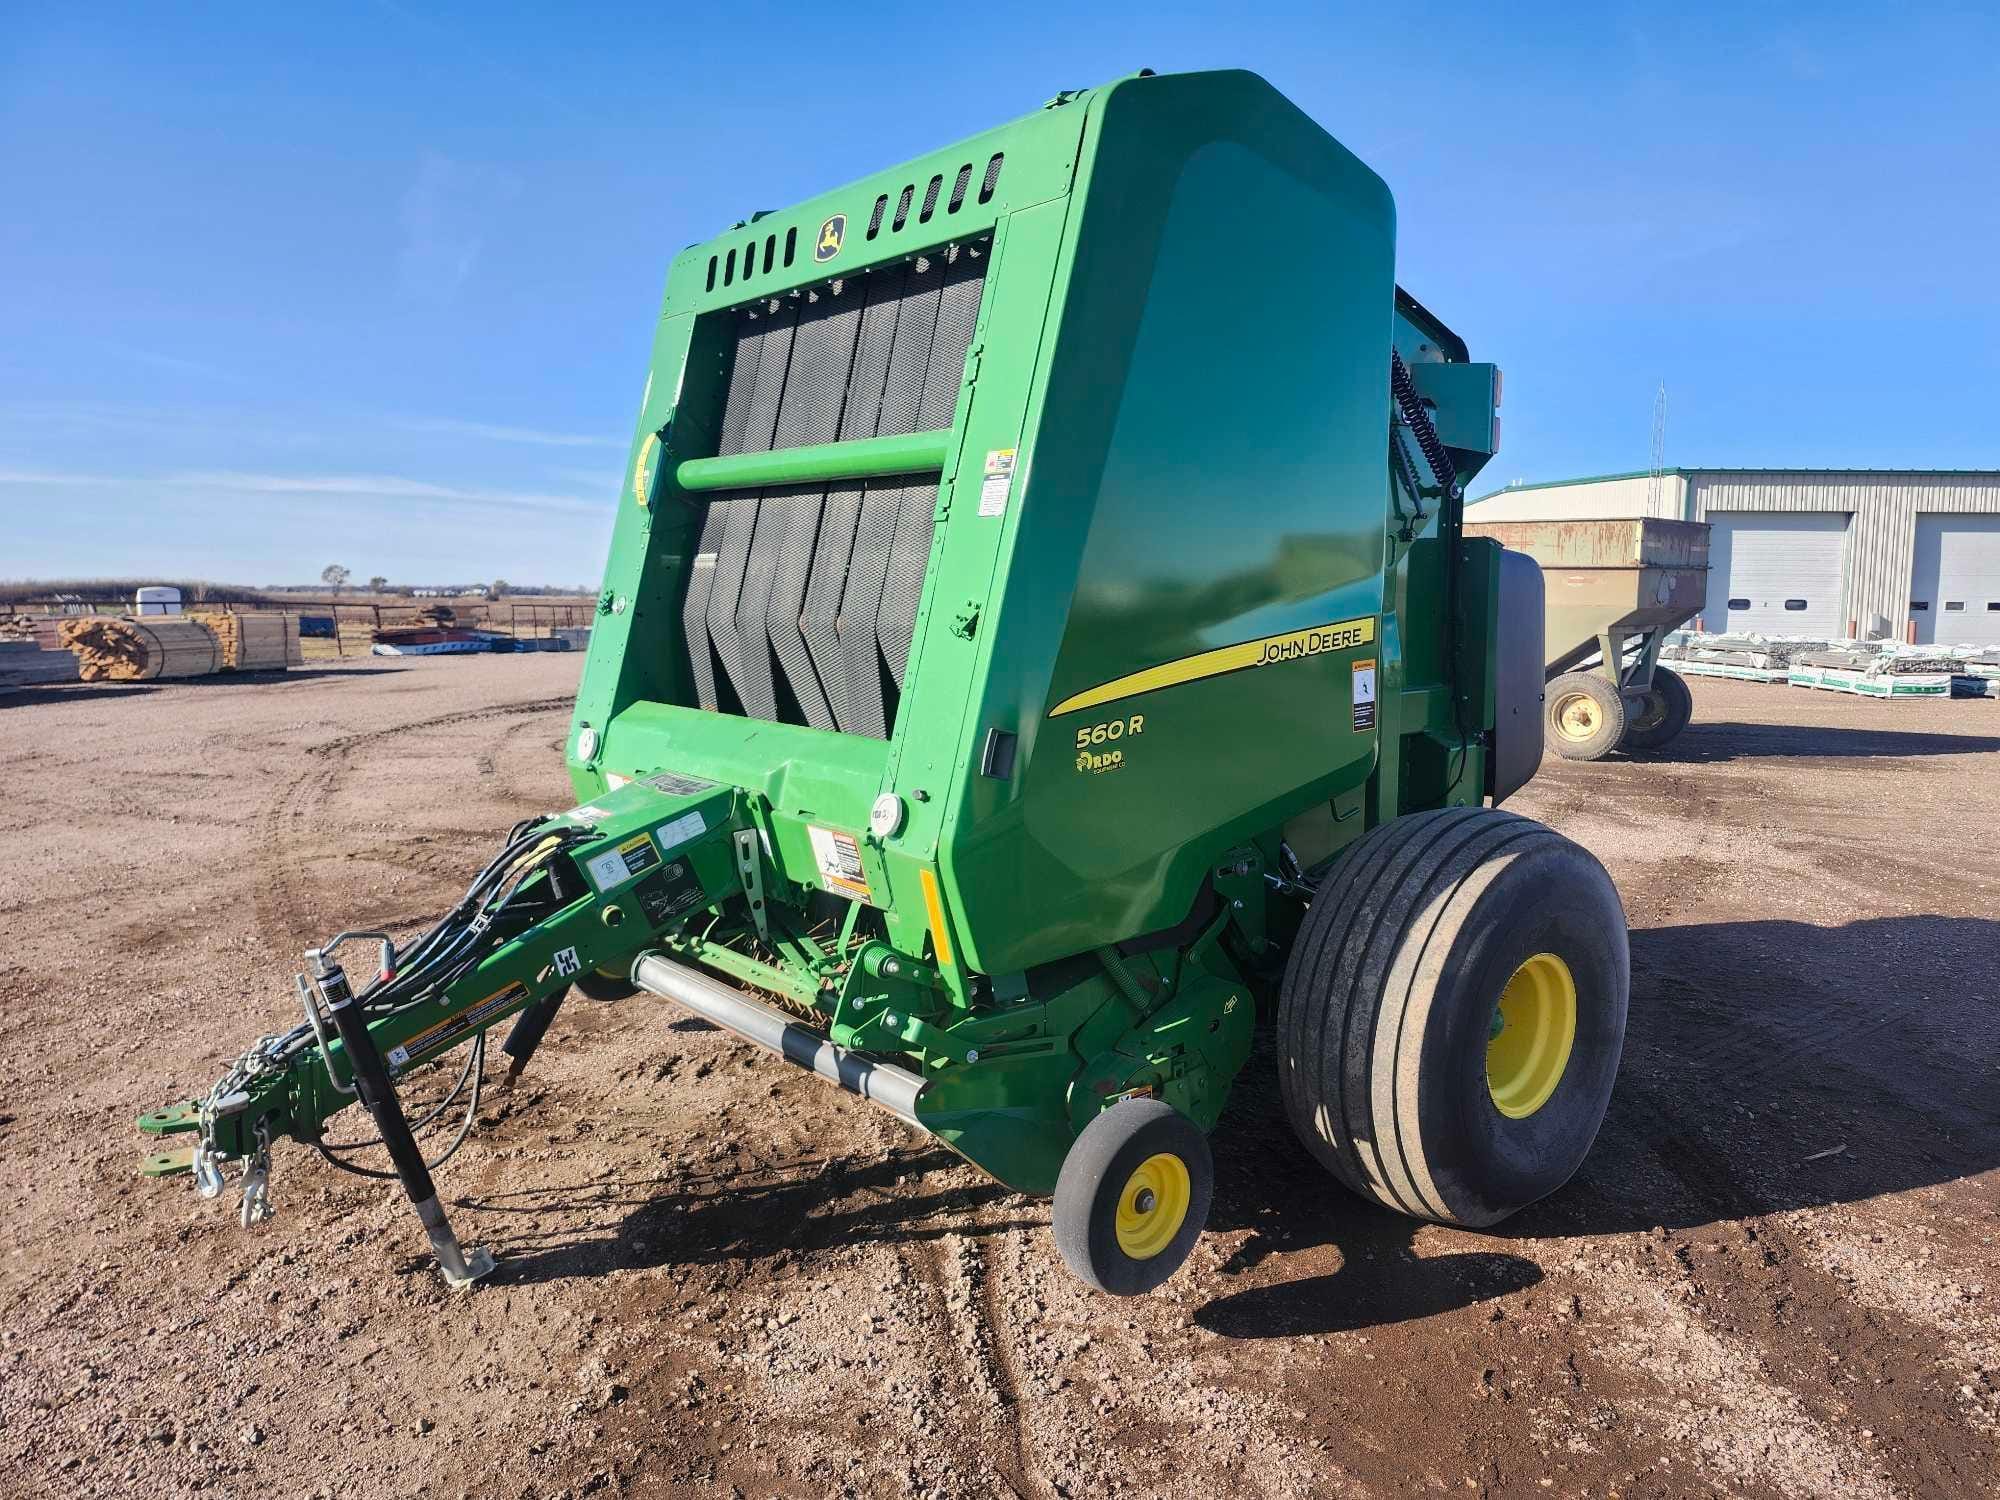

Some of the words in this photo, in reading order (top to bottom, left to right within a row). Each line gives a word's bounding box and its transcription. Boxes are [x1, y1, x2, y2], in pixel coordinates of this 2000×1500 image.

[1257, 639, 1305, 664] JOHN
[1308, 628, 1362, 652] DEERE
[1076, 720, 1125, 749] 560
[1128, 714, 1144, 736] R
[1093, 750, 1122, 769] RDO
